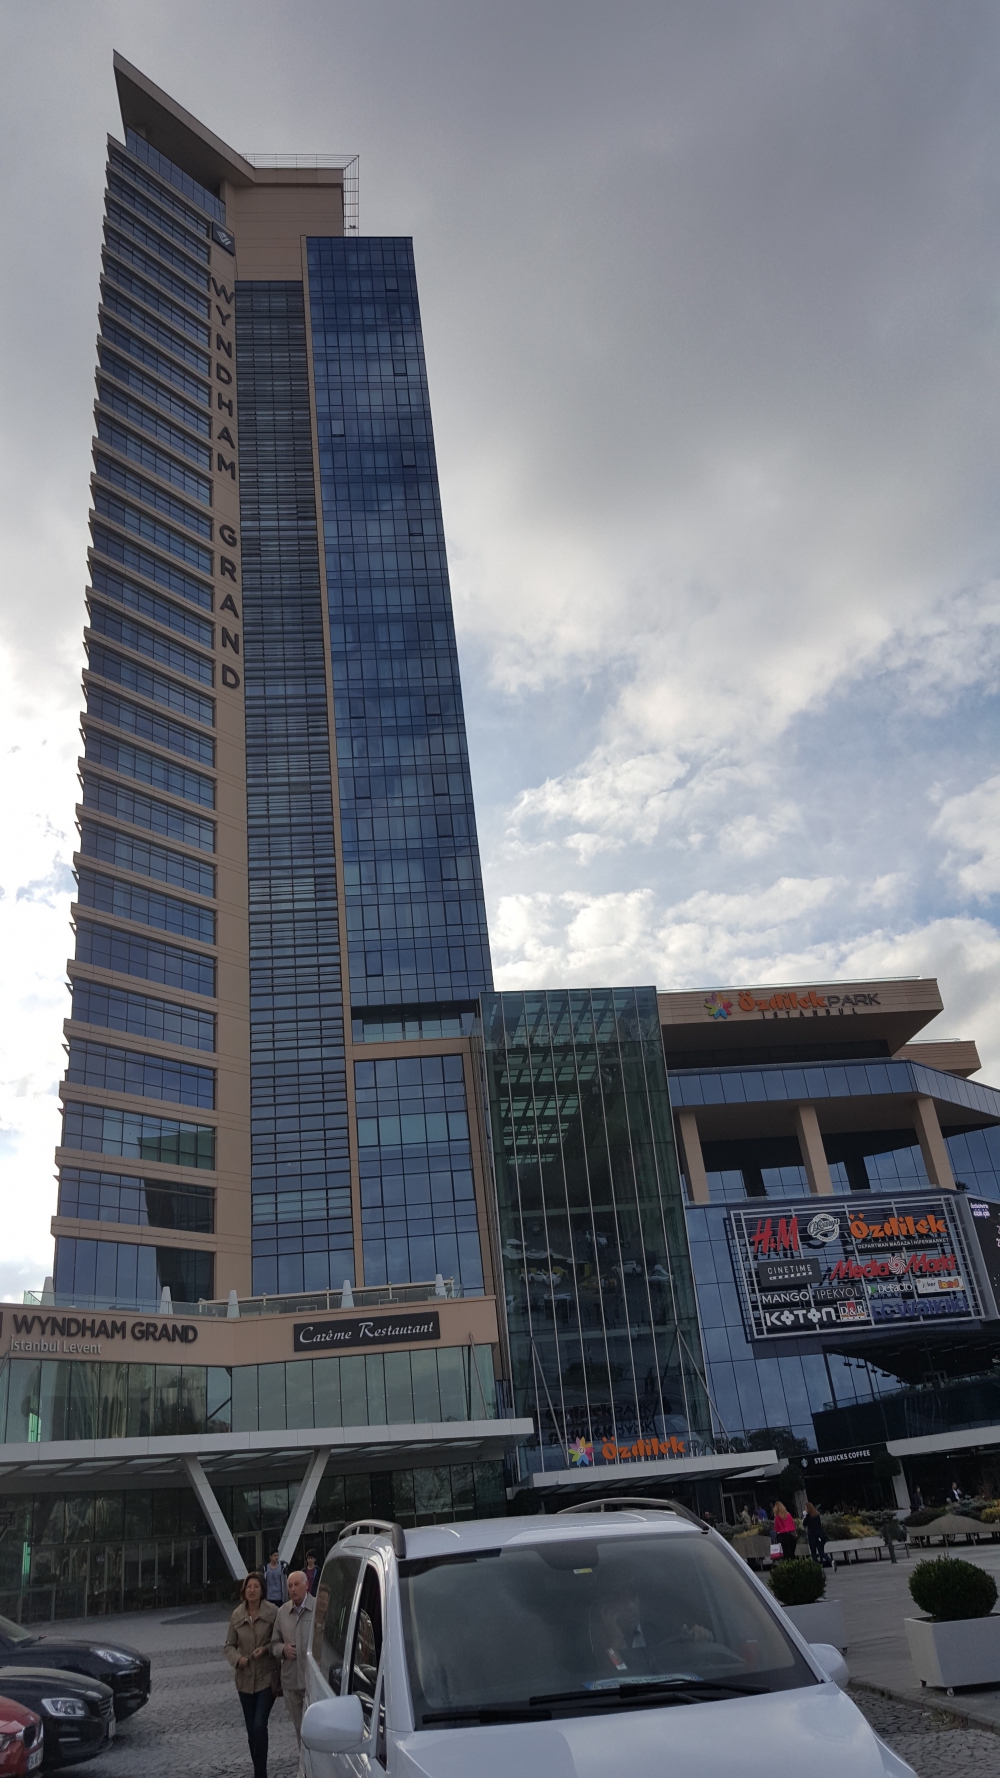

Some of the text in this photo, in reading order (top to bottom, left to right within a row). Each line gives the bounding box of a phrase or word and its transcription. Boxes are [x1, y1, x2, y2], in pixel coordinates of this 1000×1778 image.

[211, 276, 241, 689] WYNDHAM GRAND
[751, 1216, 799, 1254] H&M
[849, 1213, 948, 1239] Özdilek
[767, 1264, 812, 1275] CINETIME
[829, 1253, 956, 1280] Media Markt
[878, 1282, 913, 1293] DeFacto
[938, 1278, 960, 1289] land
[762, 1291, 810, 1304] MANGO
[872, 1297, 969, 1319] LC Waikiki
[840, 1304, 864, 1316] D&R
[13, 1314, 199, 1344] WYNDHAM GRAND
[300, 1321, 434, 1343] Carême Restaurant
[63, 1339, 102, 1355] Levent
[601, 1435, 686, 1460] Özdilek
[814, 1450, 871, 1465] STARBUCKS COFFEE
